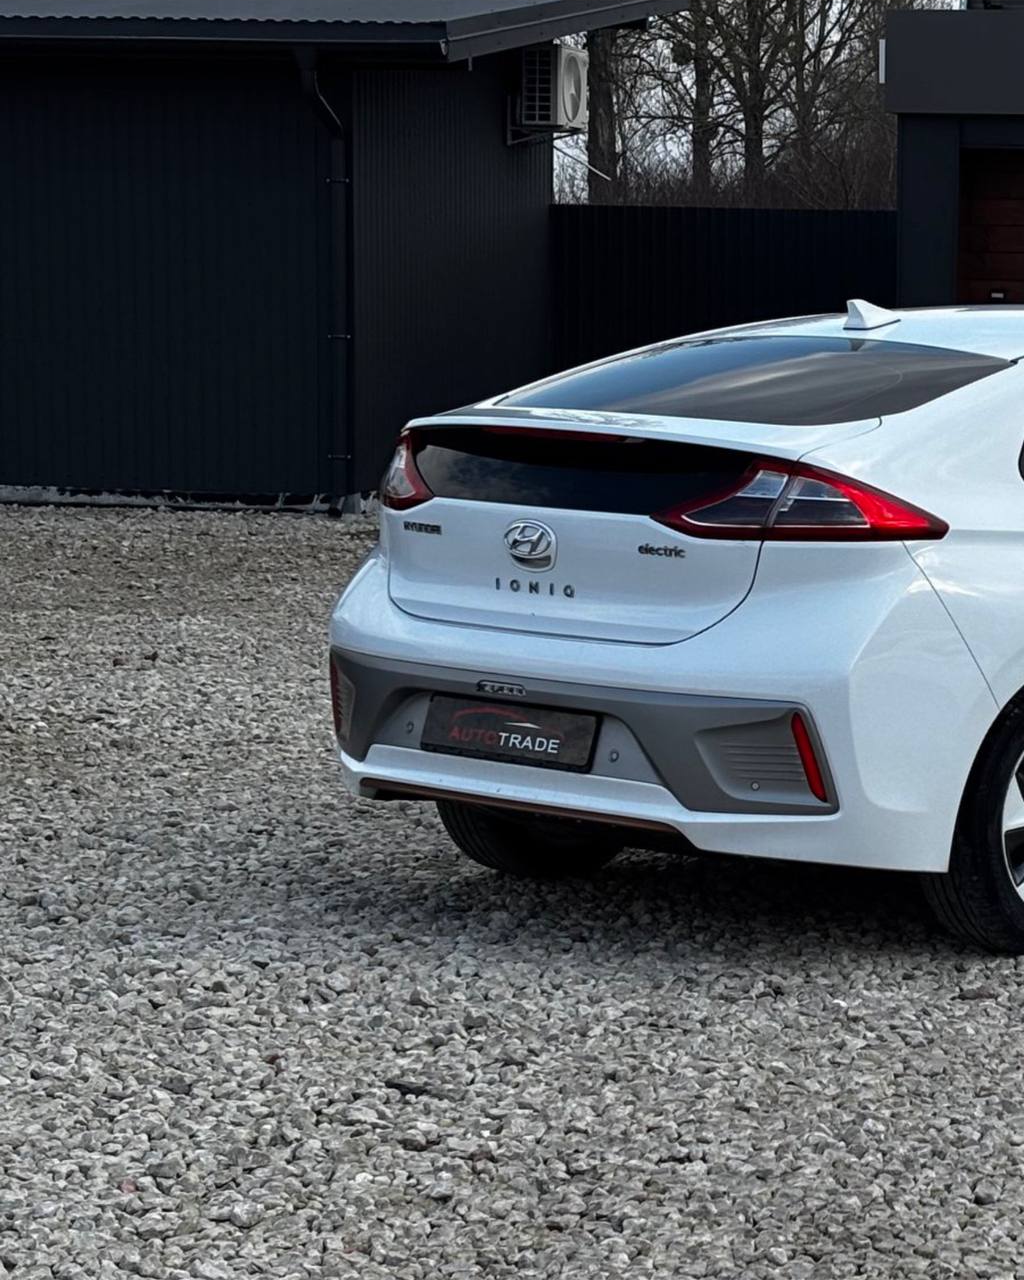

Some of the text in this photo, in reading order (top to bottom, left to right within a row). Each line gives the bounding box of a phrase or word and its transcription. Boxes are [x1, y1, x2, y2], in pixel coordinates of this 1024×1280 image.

[638, 543, 686, 559] electric
[495, 577, 575, 598] IONIQ
[450, 725, 560, 754] AUTOTRADE
